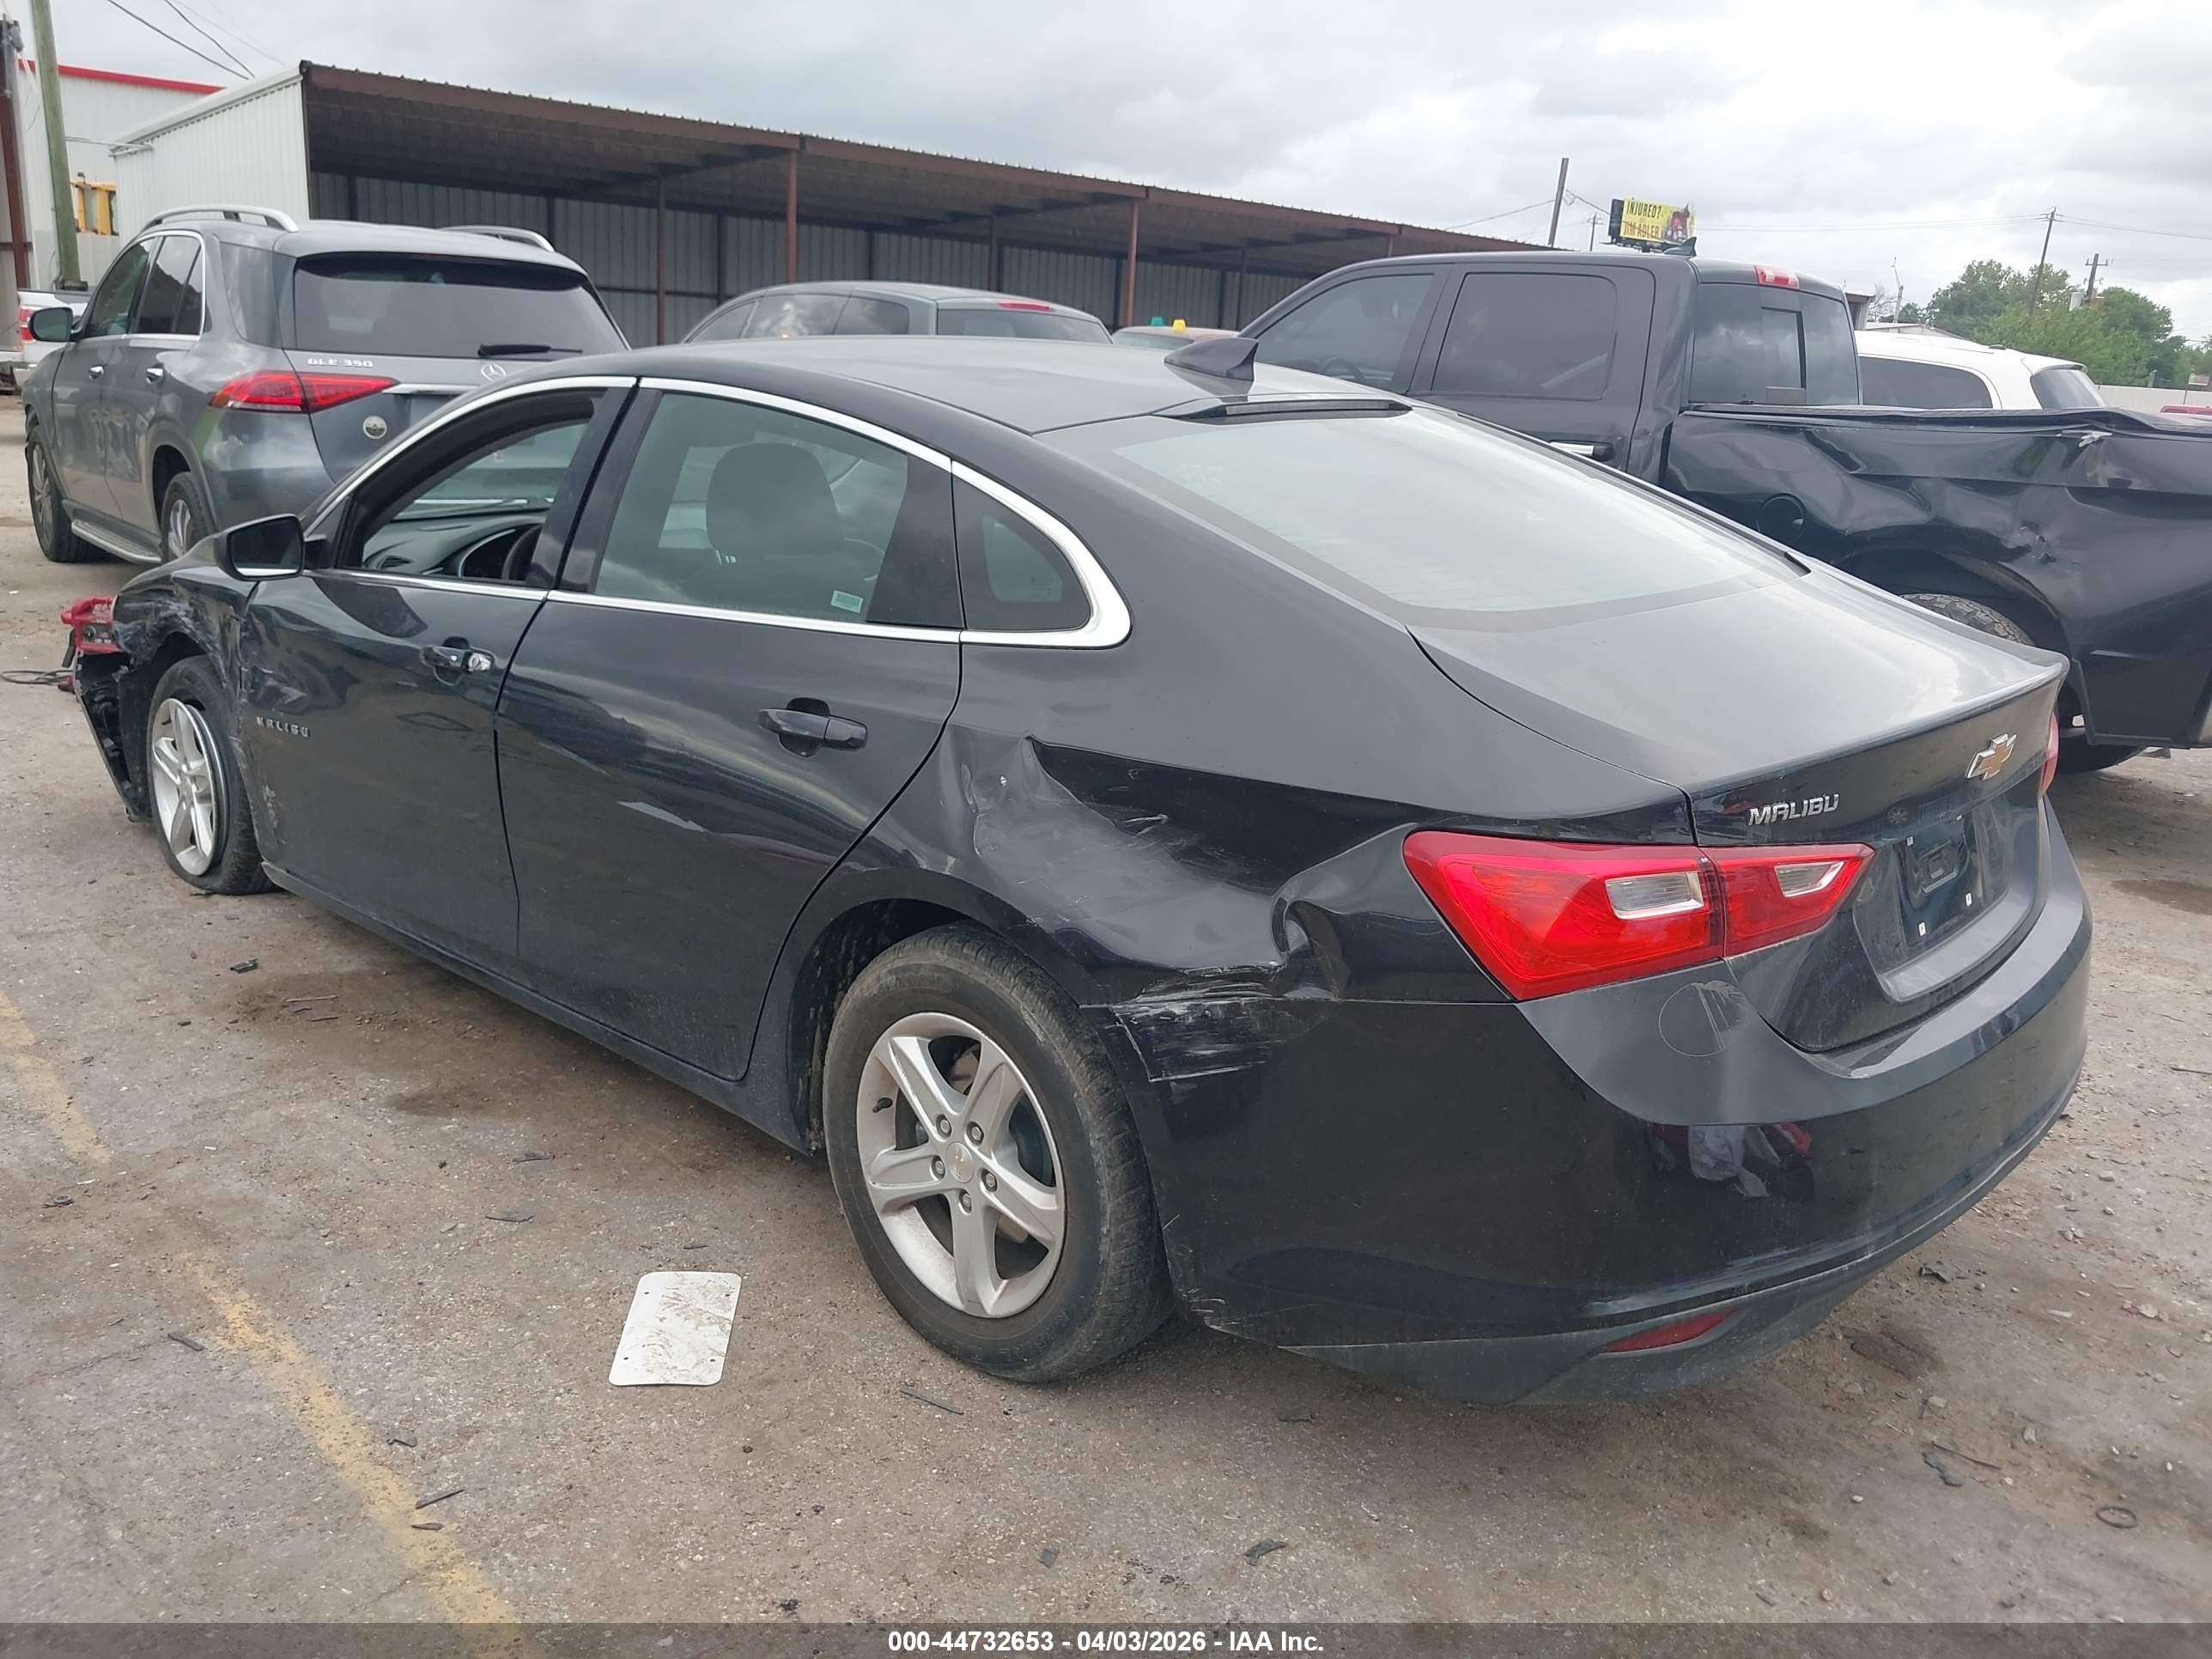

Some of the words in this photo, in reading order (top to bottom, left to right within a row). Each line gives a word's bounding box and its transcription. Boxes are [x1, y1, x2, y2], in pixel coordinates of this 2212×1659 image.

[1626, 200, 1662, 219] INJURED?
[307, 357, 337, 367] GLE
[343, 359, 373, 368] 350
[256, 716, 309, 738] MALIBU
[1747, 793, 1839, 826] MALIBU
